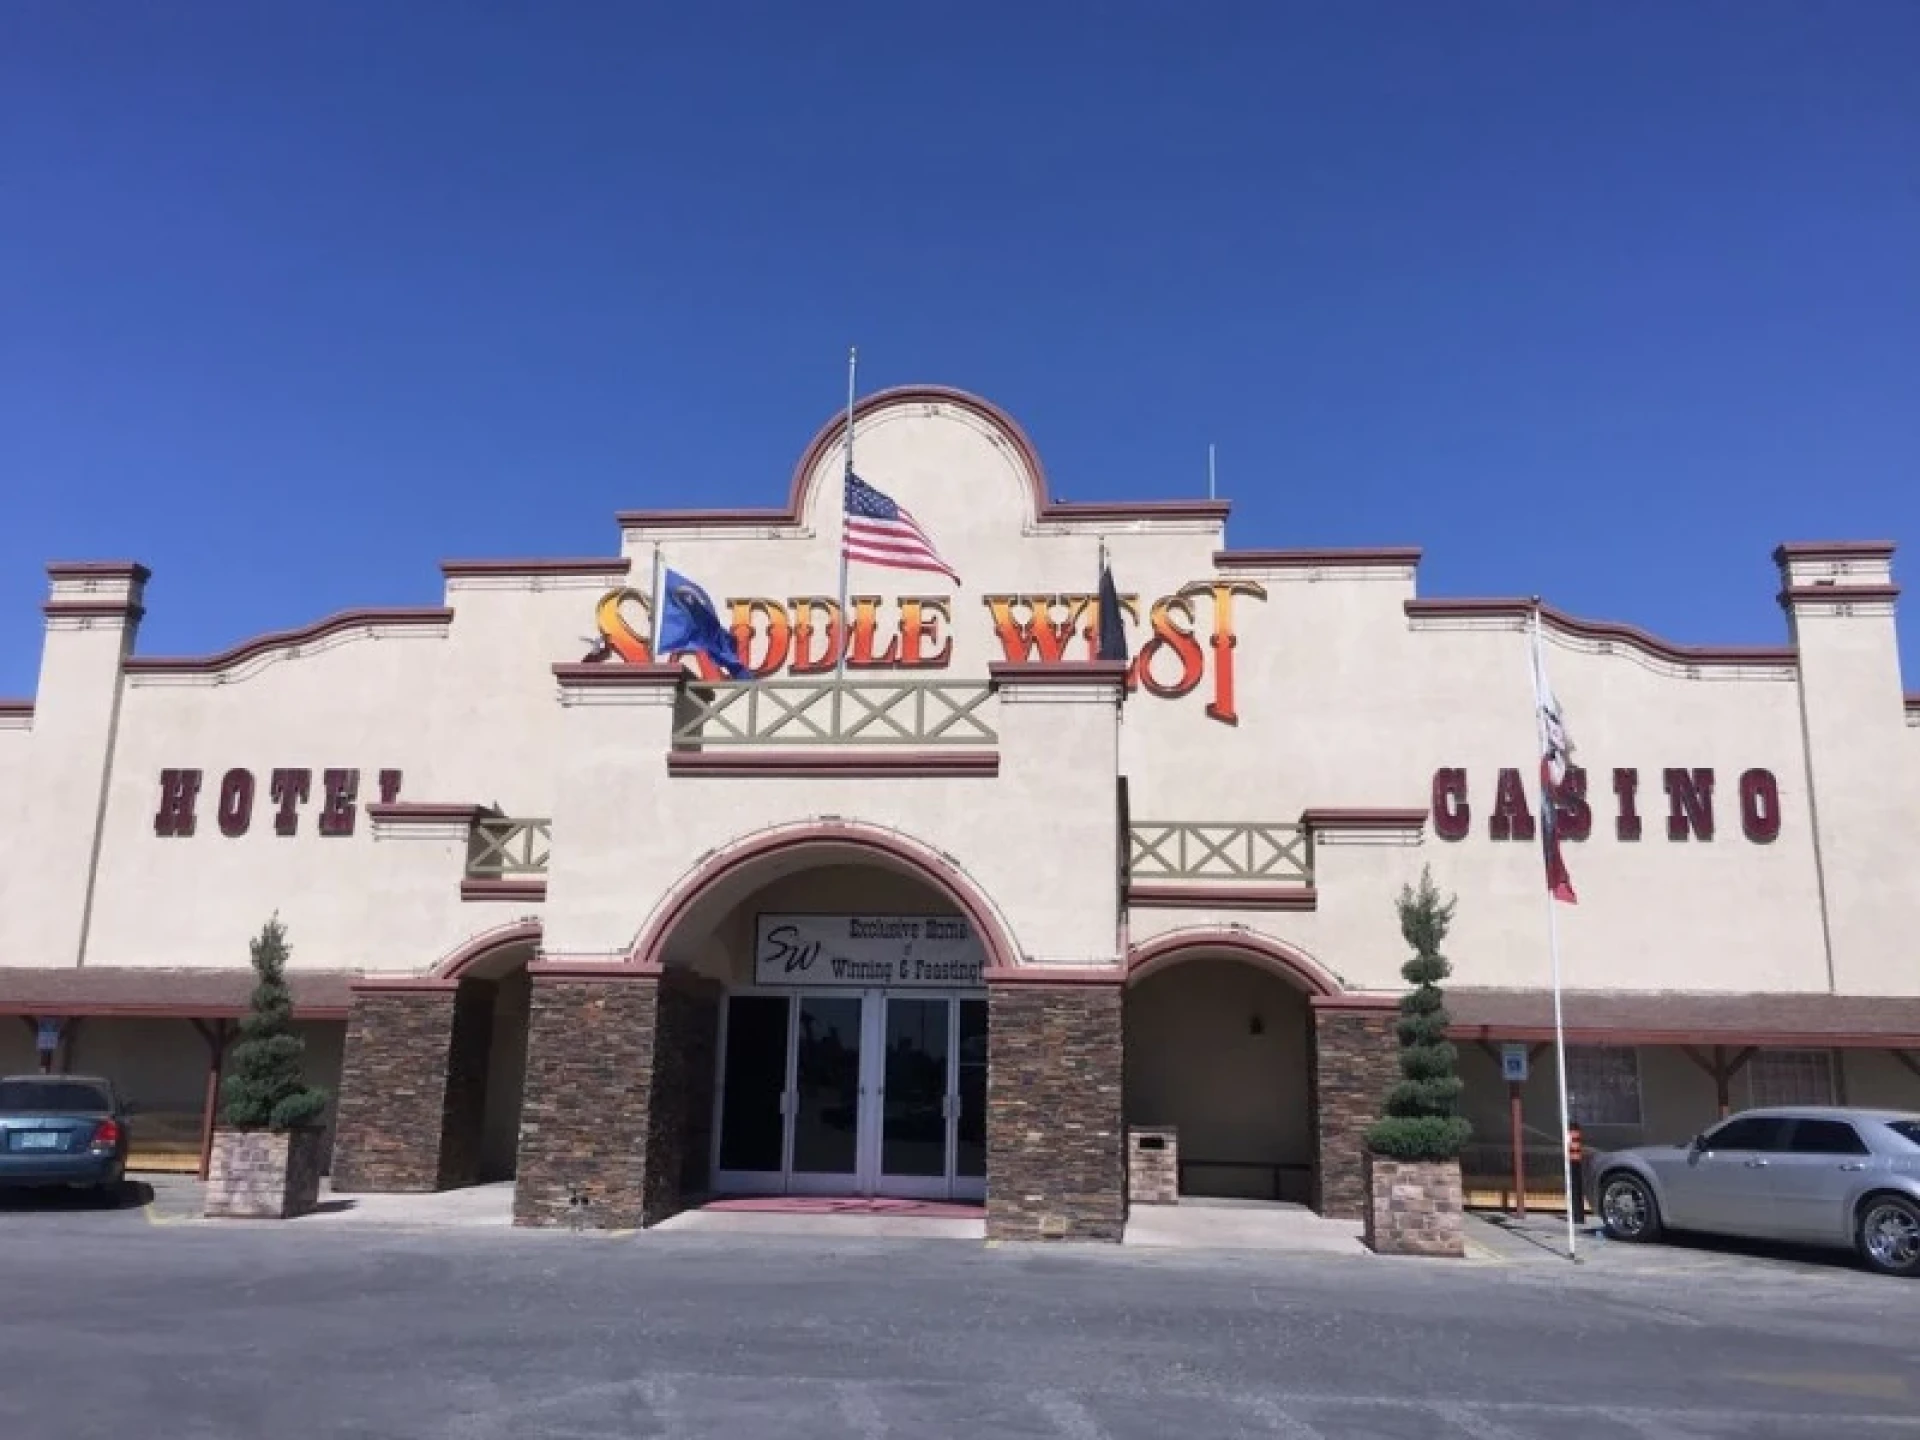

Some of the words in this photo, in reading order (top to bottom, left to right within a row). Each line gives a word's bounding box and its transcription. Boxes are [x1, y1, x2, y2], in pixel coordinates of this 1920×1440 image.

[595, 587, 952, 680] SDDLE
[849, 918, 919, 939] Exclusive
[925, 919, 968, 939] Home
[831, 959, 894, 983] Winning
